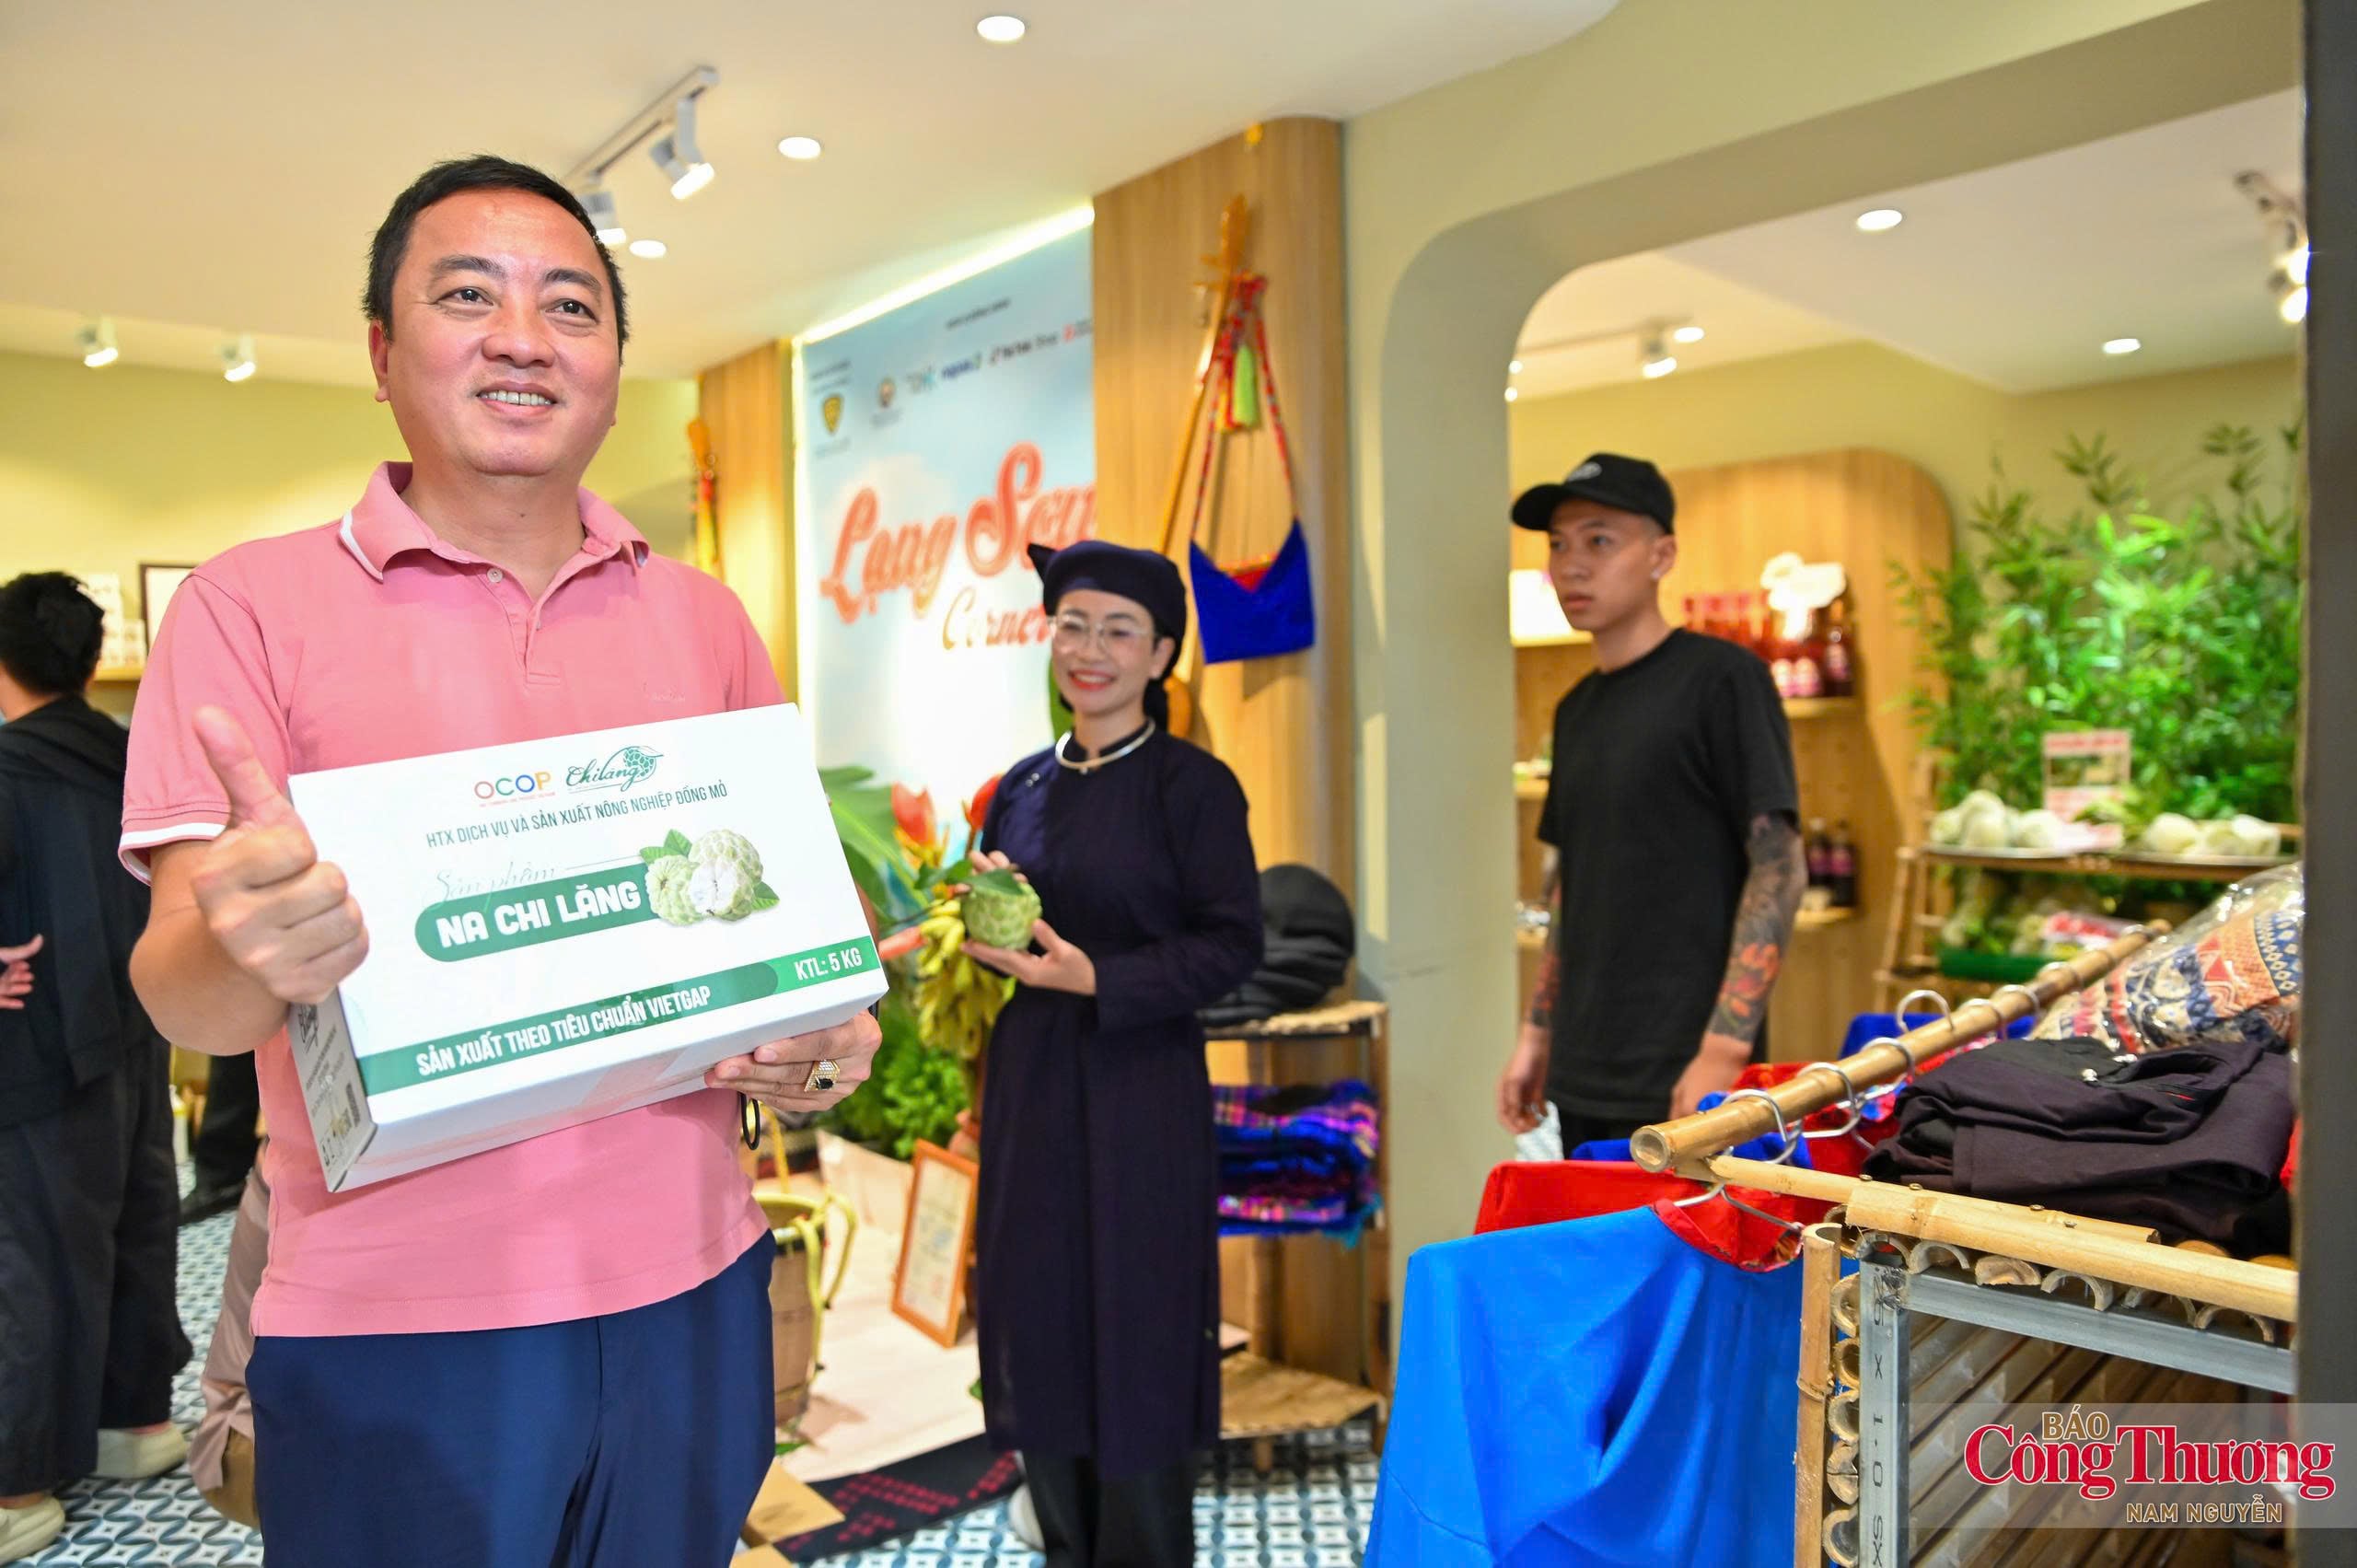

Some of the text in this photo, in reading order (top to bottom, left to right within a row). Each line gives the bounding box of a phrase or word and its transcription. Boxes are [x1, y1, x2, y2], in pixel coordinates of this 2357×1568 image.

[426, 779, 728, 848] HTX DỊCH VỤ VÀ SẢN XUẤT NÔNG NGHIỆP ĐỒNG MỎ
[474, 771, 552, 799] OCOP
[435, 883, 642, 948] NA CHI LĂNG
[794, 947, 863, 981] KTL: 5 KG
[415, 985, 712, 1076] SẢN XUẤT THEO TIÊU CHUẨN VIETGAP
